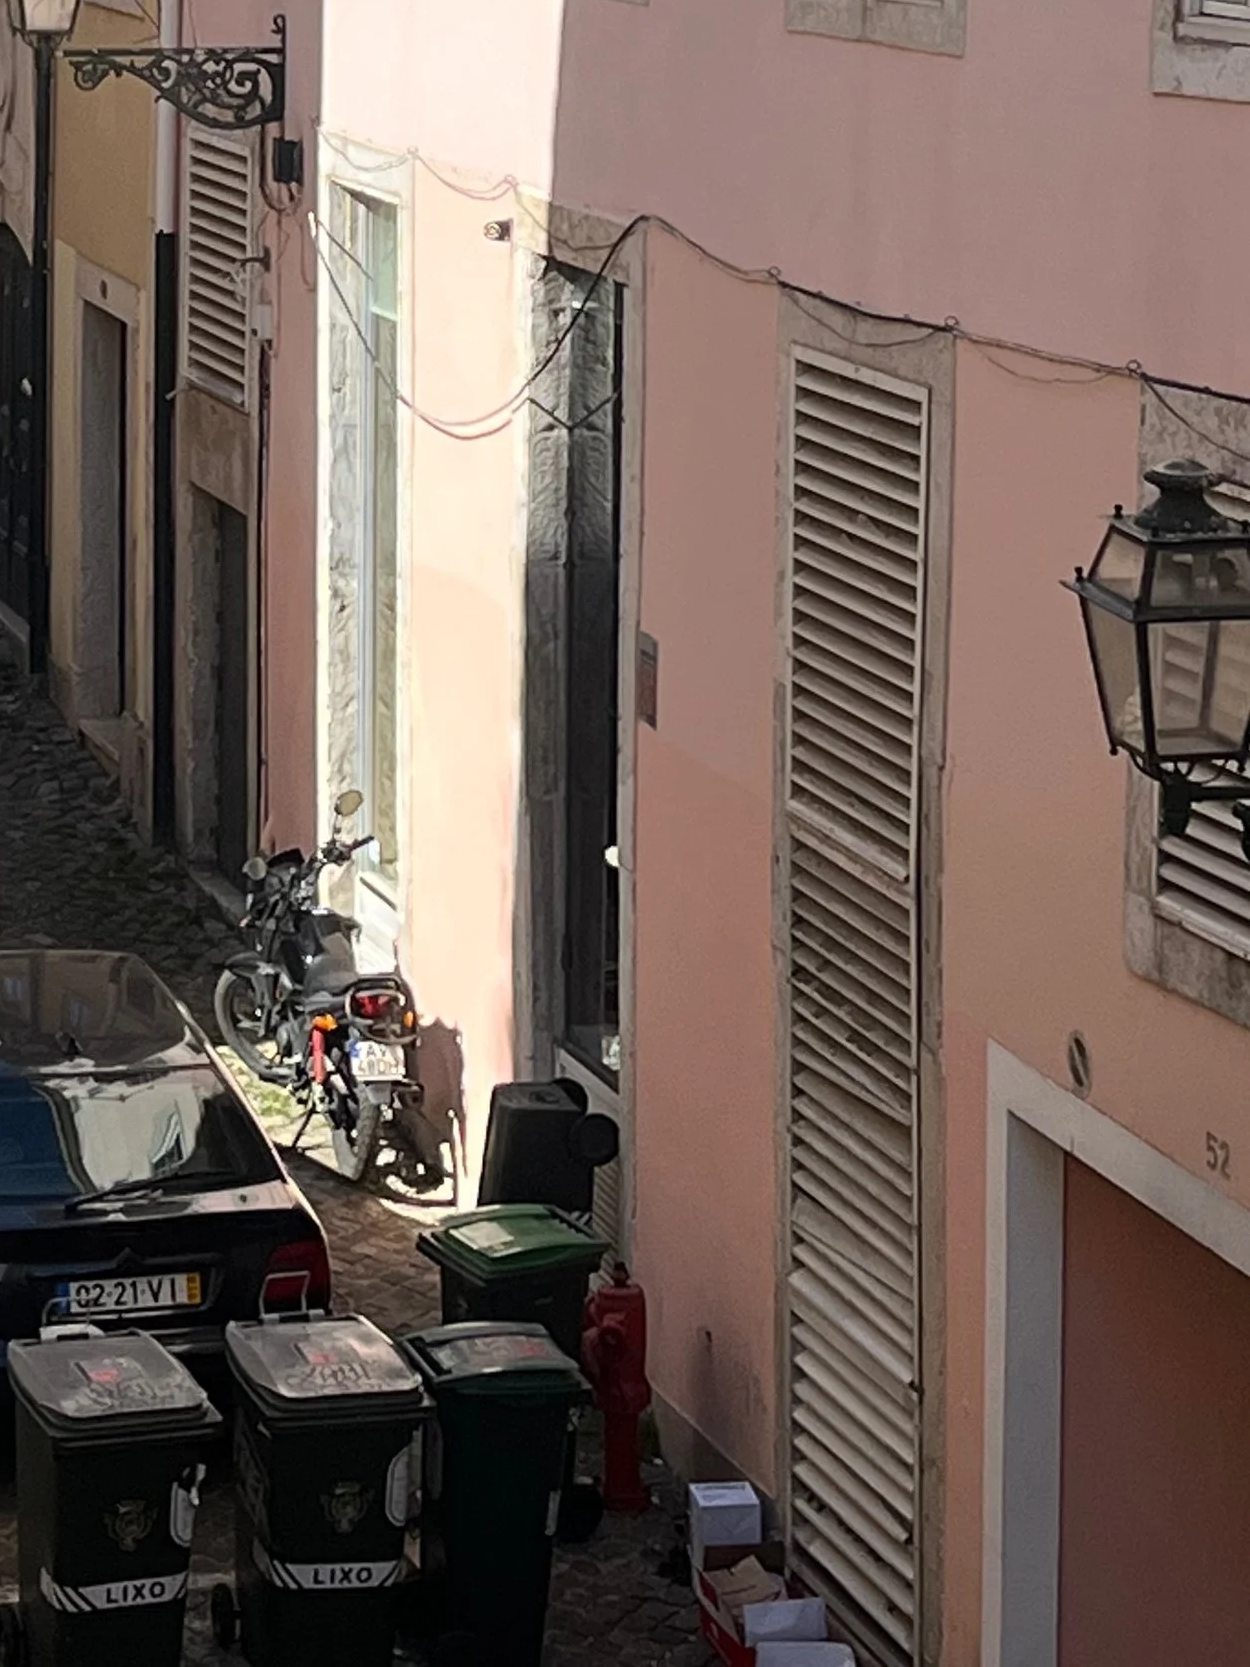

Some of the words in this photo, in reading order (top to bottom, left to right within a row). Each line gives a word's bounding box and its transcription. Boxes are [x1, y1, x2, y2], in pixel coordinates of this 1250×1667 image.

[1206, 1130, 1231, 1182] 52
[312, 1567, 373, 1585] LIXO
[106, 1581, 166, 1604] LIXO
